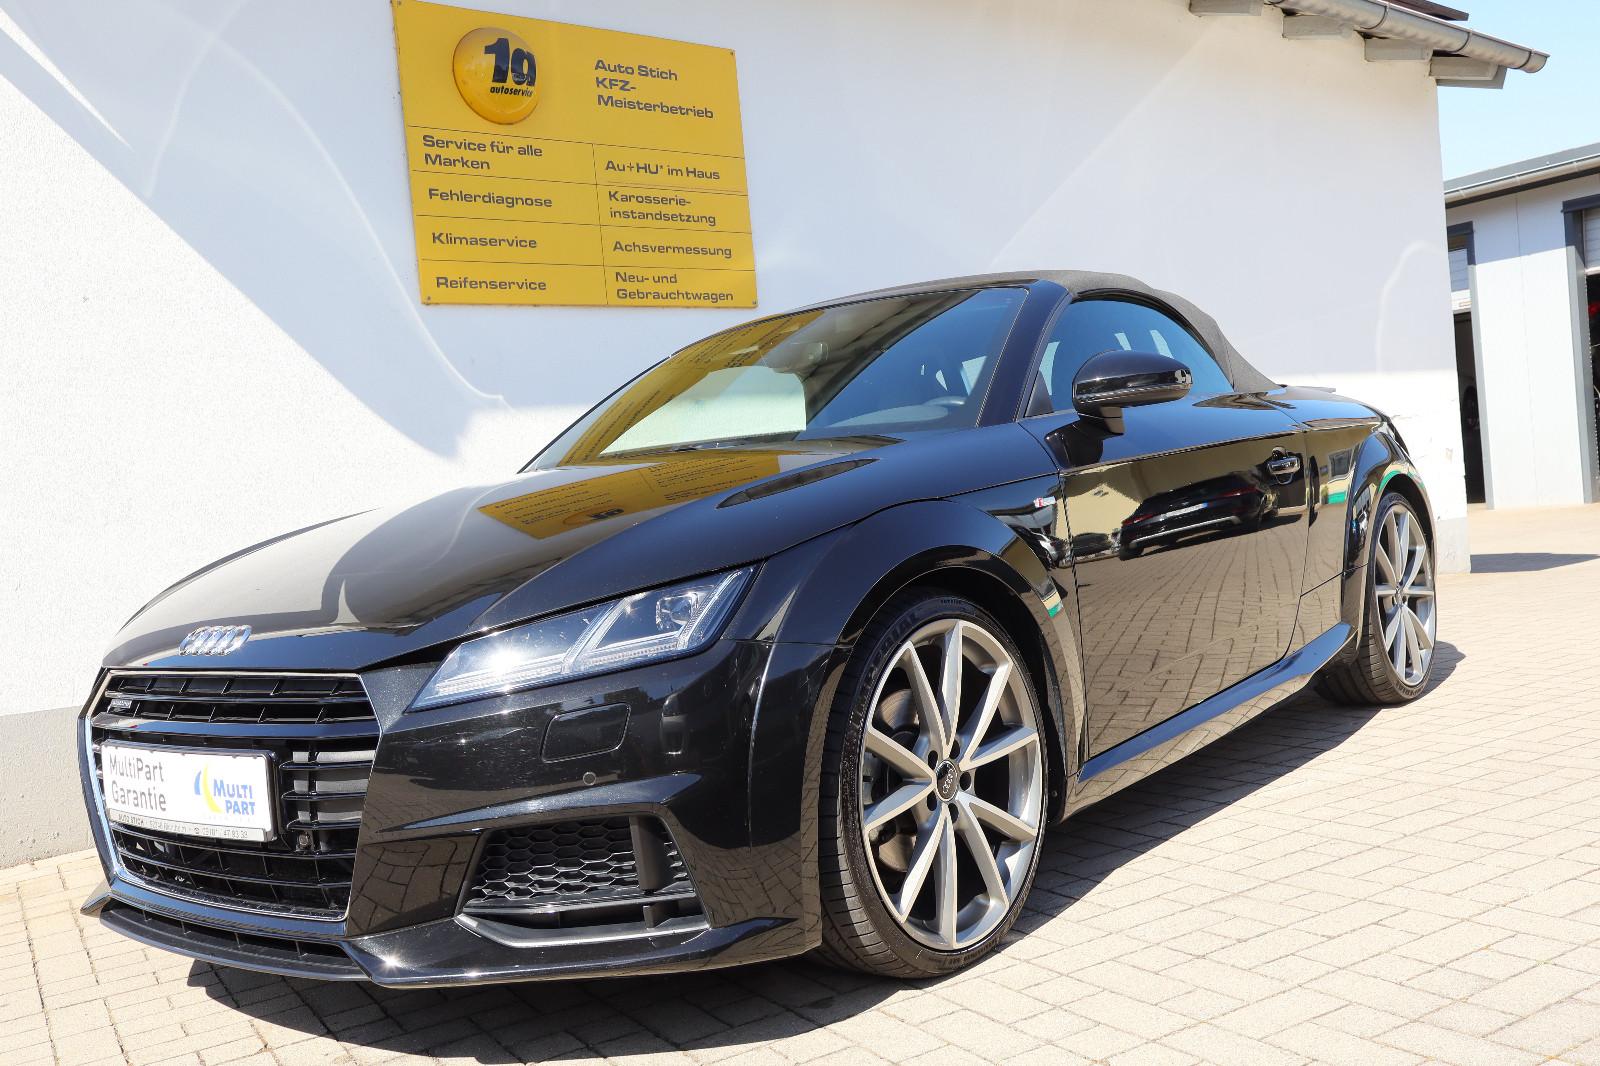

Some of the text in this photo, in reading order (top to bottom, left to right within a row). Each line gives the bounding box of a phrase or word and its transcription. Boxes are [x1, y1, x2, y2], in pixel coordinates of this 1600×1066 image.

[594, 59, 678, 82] Auto Stich
[489, 85, 534, 98] autoservice
[595, 76, 637, 92] KFZ-
[597, 94, 714, 119] Meisterbetrieb
[422, 134, 543, 157] Service für alle
[424, 153, 490, 170] Marken
[667, 165, 684, 177] im
[685, 166, 721, 180] Haus
[428, 187, 553, 209] Fehlerdiagnose
[608, 190, 692, 206] Karosserie-
[610, 207, 716, 227] instandsetzung
[431, 232, 537, 249] Klimaservice
[612, 240, 732, 259] Achsvermessung
[435, 276, 547, 291] Reifenservice
[615, 271, 678, 284] Neu- und
[616, 288, 734, 302] Gebrauchtwagen
[109, 754, 164, 782] MultiPart
[111, 780, 166, 812] Garantie
[213, 779, 253, 799] MULTI
[225, 800, 256, 815] PART
